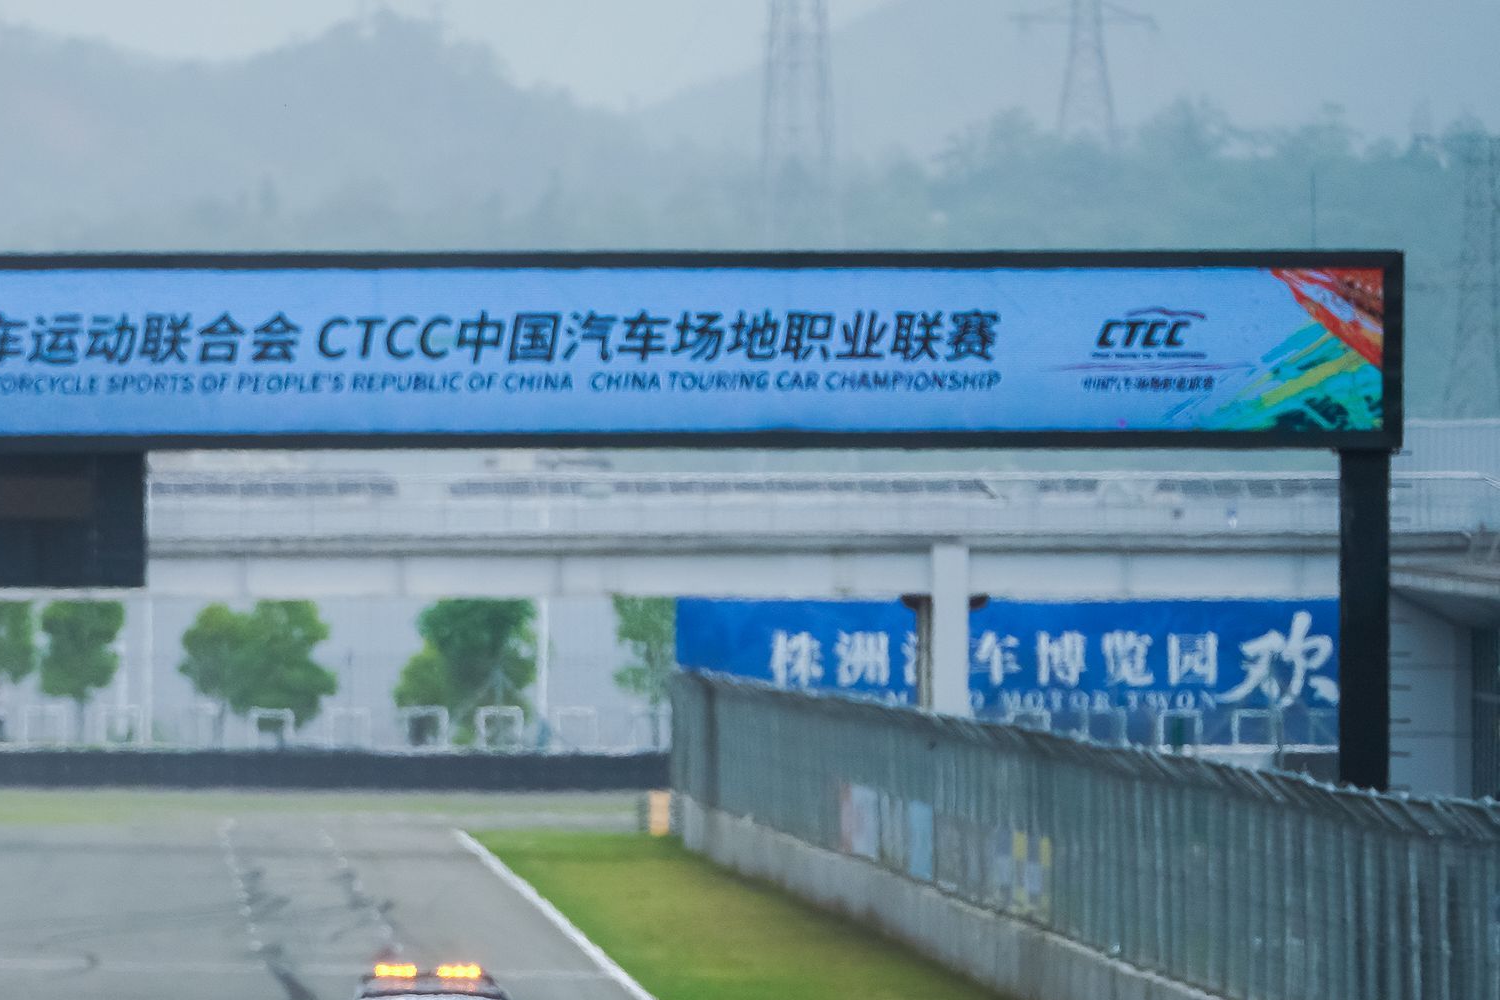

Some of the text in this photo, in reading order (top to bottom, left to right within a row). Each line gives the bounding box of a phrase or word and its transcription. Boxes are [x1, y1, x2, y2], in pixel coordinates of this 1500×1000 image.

[317, 308, 1000, 364] CTCC中国汽车场地职业联赛
[1097, 319, 1190, 347] CTCC
[106, 373, 195, 394] SPORTS
[202, 373, 229, 393] OF
[237, 373, 344, 393] PEOPLE'S
[352, 372, 459, 393] REPUBLIC
[467, 372, 499, 392] OF
[502, 372, 574, 392] CHINA
[590, 371, 662, 392] CHINA
[668, 371, 769, 392] TOURING
[775, 371, 819, 392] CAR
[825, 370, 1000, 391] CHAMPIONSHIP
[771, 629, 1218, 690] 株洲车博览园
